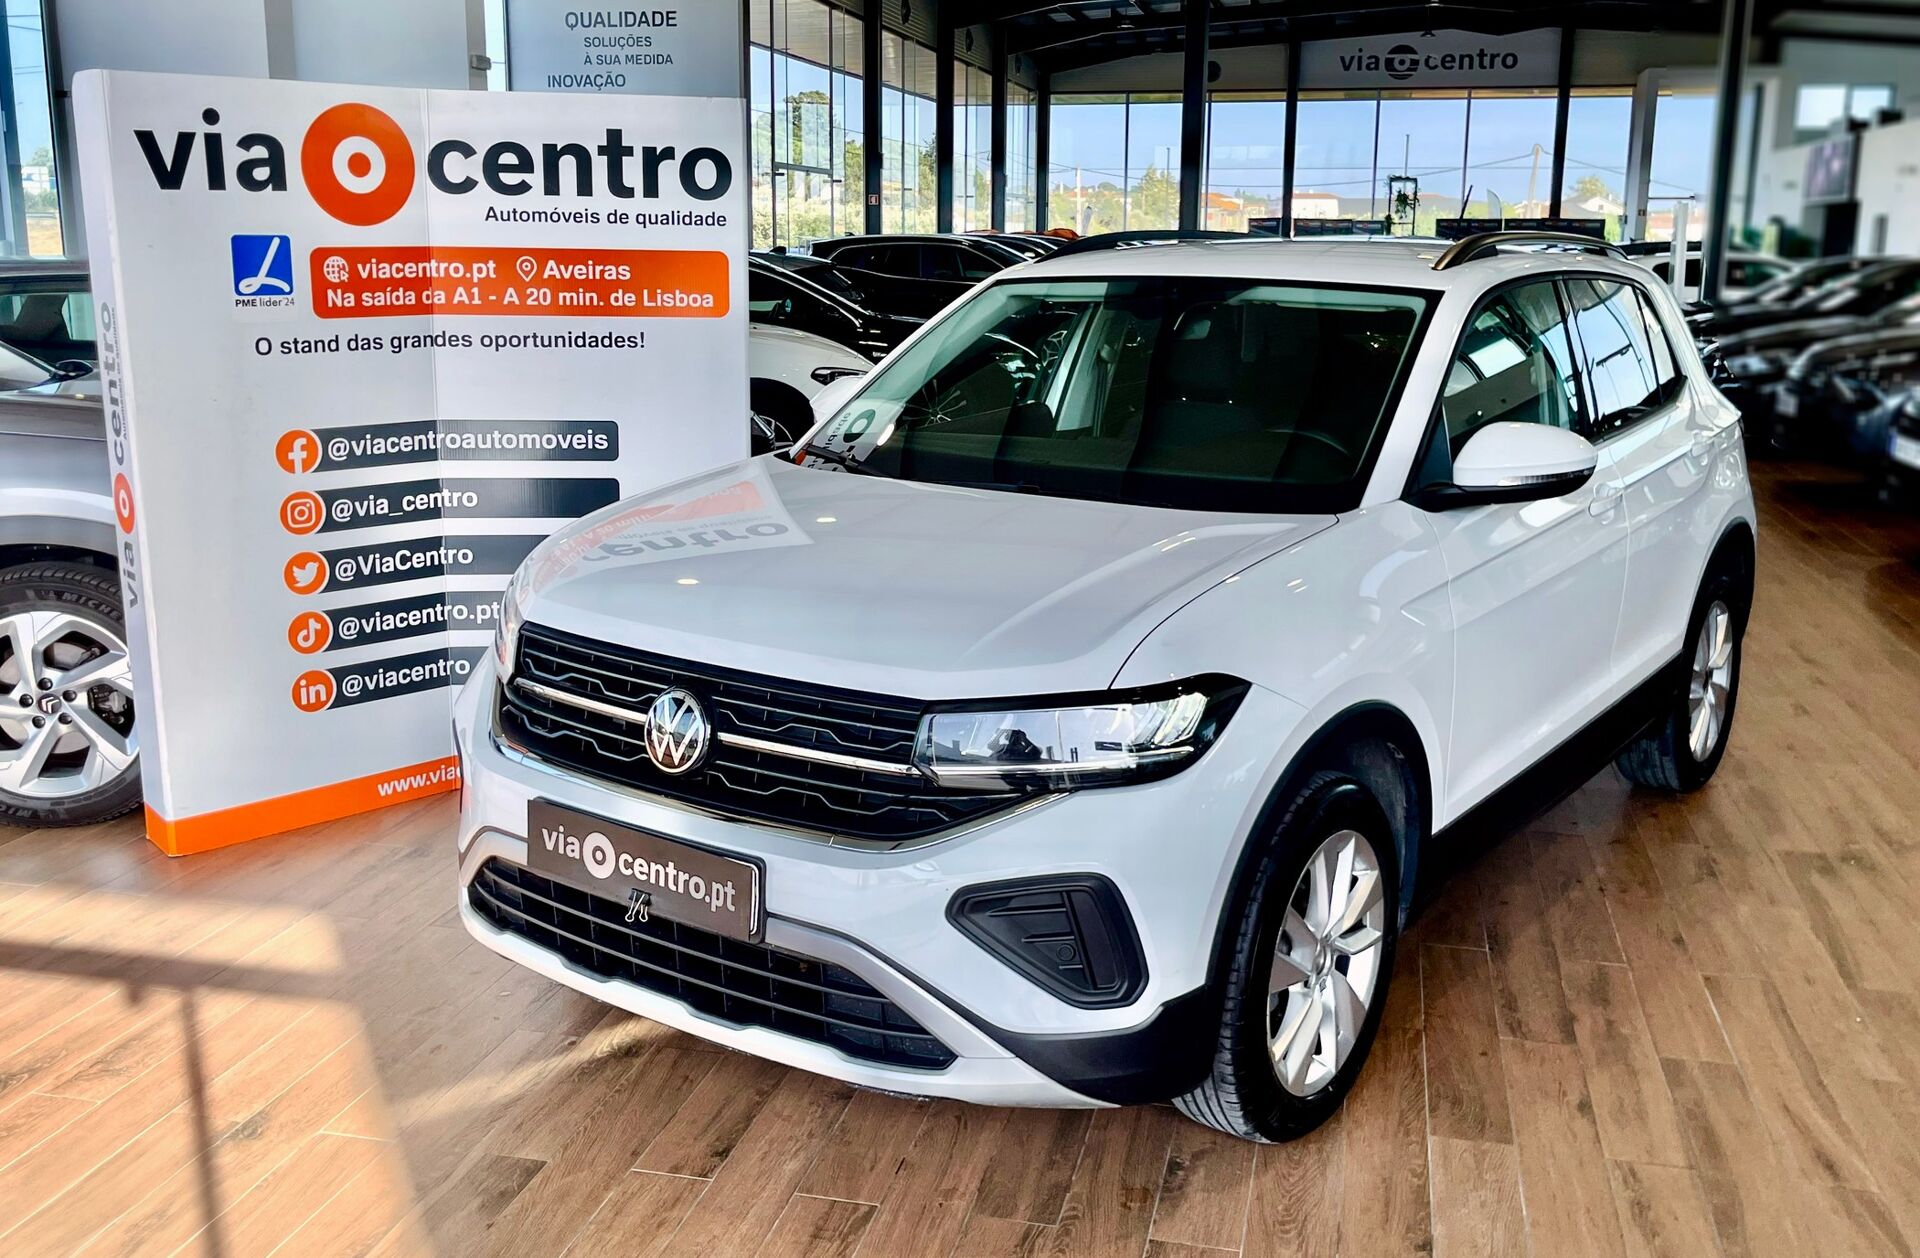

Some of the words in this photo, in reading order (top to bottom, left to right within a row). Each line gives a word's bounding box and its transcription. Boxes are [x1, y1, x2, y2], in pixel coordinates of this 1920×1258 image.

[565, 11, 678, 31] QUALIDADE
[583, 34, 652, 50] SOLUÇÕES
[583, 52, 592, 65] À
[596, 54, 621, 65] SUA
[625, 53, 673, 65] MEDIDA
[1339, 47, 1380, 72] via
[1424, 48, 1519, 71] centro
[547, 71, 626, 91] INOVAÇÃO
[133, 107, 288, 192] via
[427, 128, 733, 201] centro
[484, 206, 601, 224] Automóveis
[606, 208, 630, 225] de
[635, 210, 728, 229] qualidade
[357, 258, 496, 282] viacentro.pt
[543, 259, 631, 280] Aveiras
[235, 298, 258, 308] PME
[326, 288, 356, 308] Na
[361, 286, 416, 307] saída
[421, 287, 446, 305] da
[452, 286, 482, 305] A1
[503, 287, 520, 305] A
[526, 288, 551, 306] 20
[559, 288, 604, 307] min.
[610, 289, 636, 307] de
[643, 289, 714, 308] Lisboa
[255, 337, 273, 356] O
[280, 334, 340, 355] stand
[347, 333, 384, 352] das
[390, 330, 473, 354] grandes
[480, 331, 645, 352] oportunidades!
[100, 302, 125, 466] centro
[327, 429, 609, 461] @viacentroautomoveis
[331, 488, 479, 523] @via_centro
[123, 541, 138, 608] via
[335, 547, 474, 582] @ViaCentro
[338, 601, 500, 640] @viacentro.pt
[341, 657, 471, 698] @viacentro
[541, 824, 581, 860] via
[618, 852, 736, 912] centro.pt
